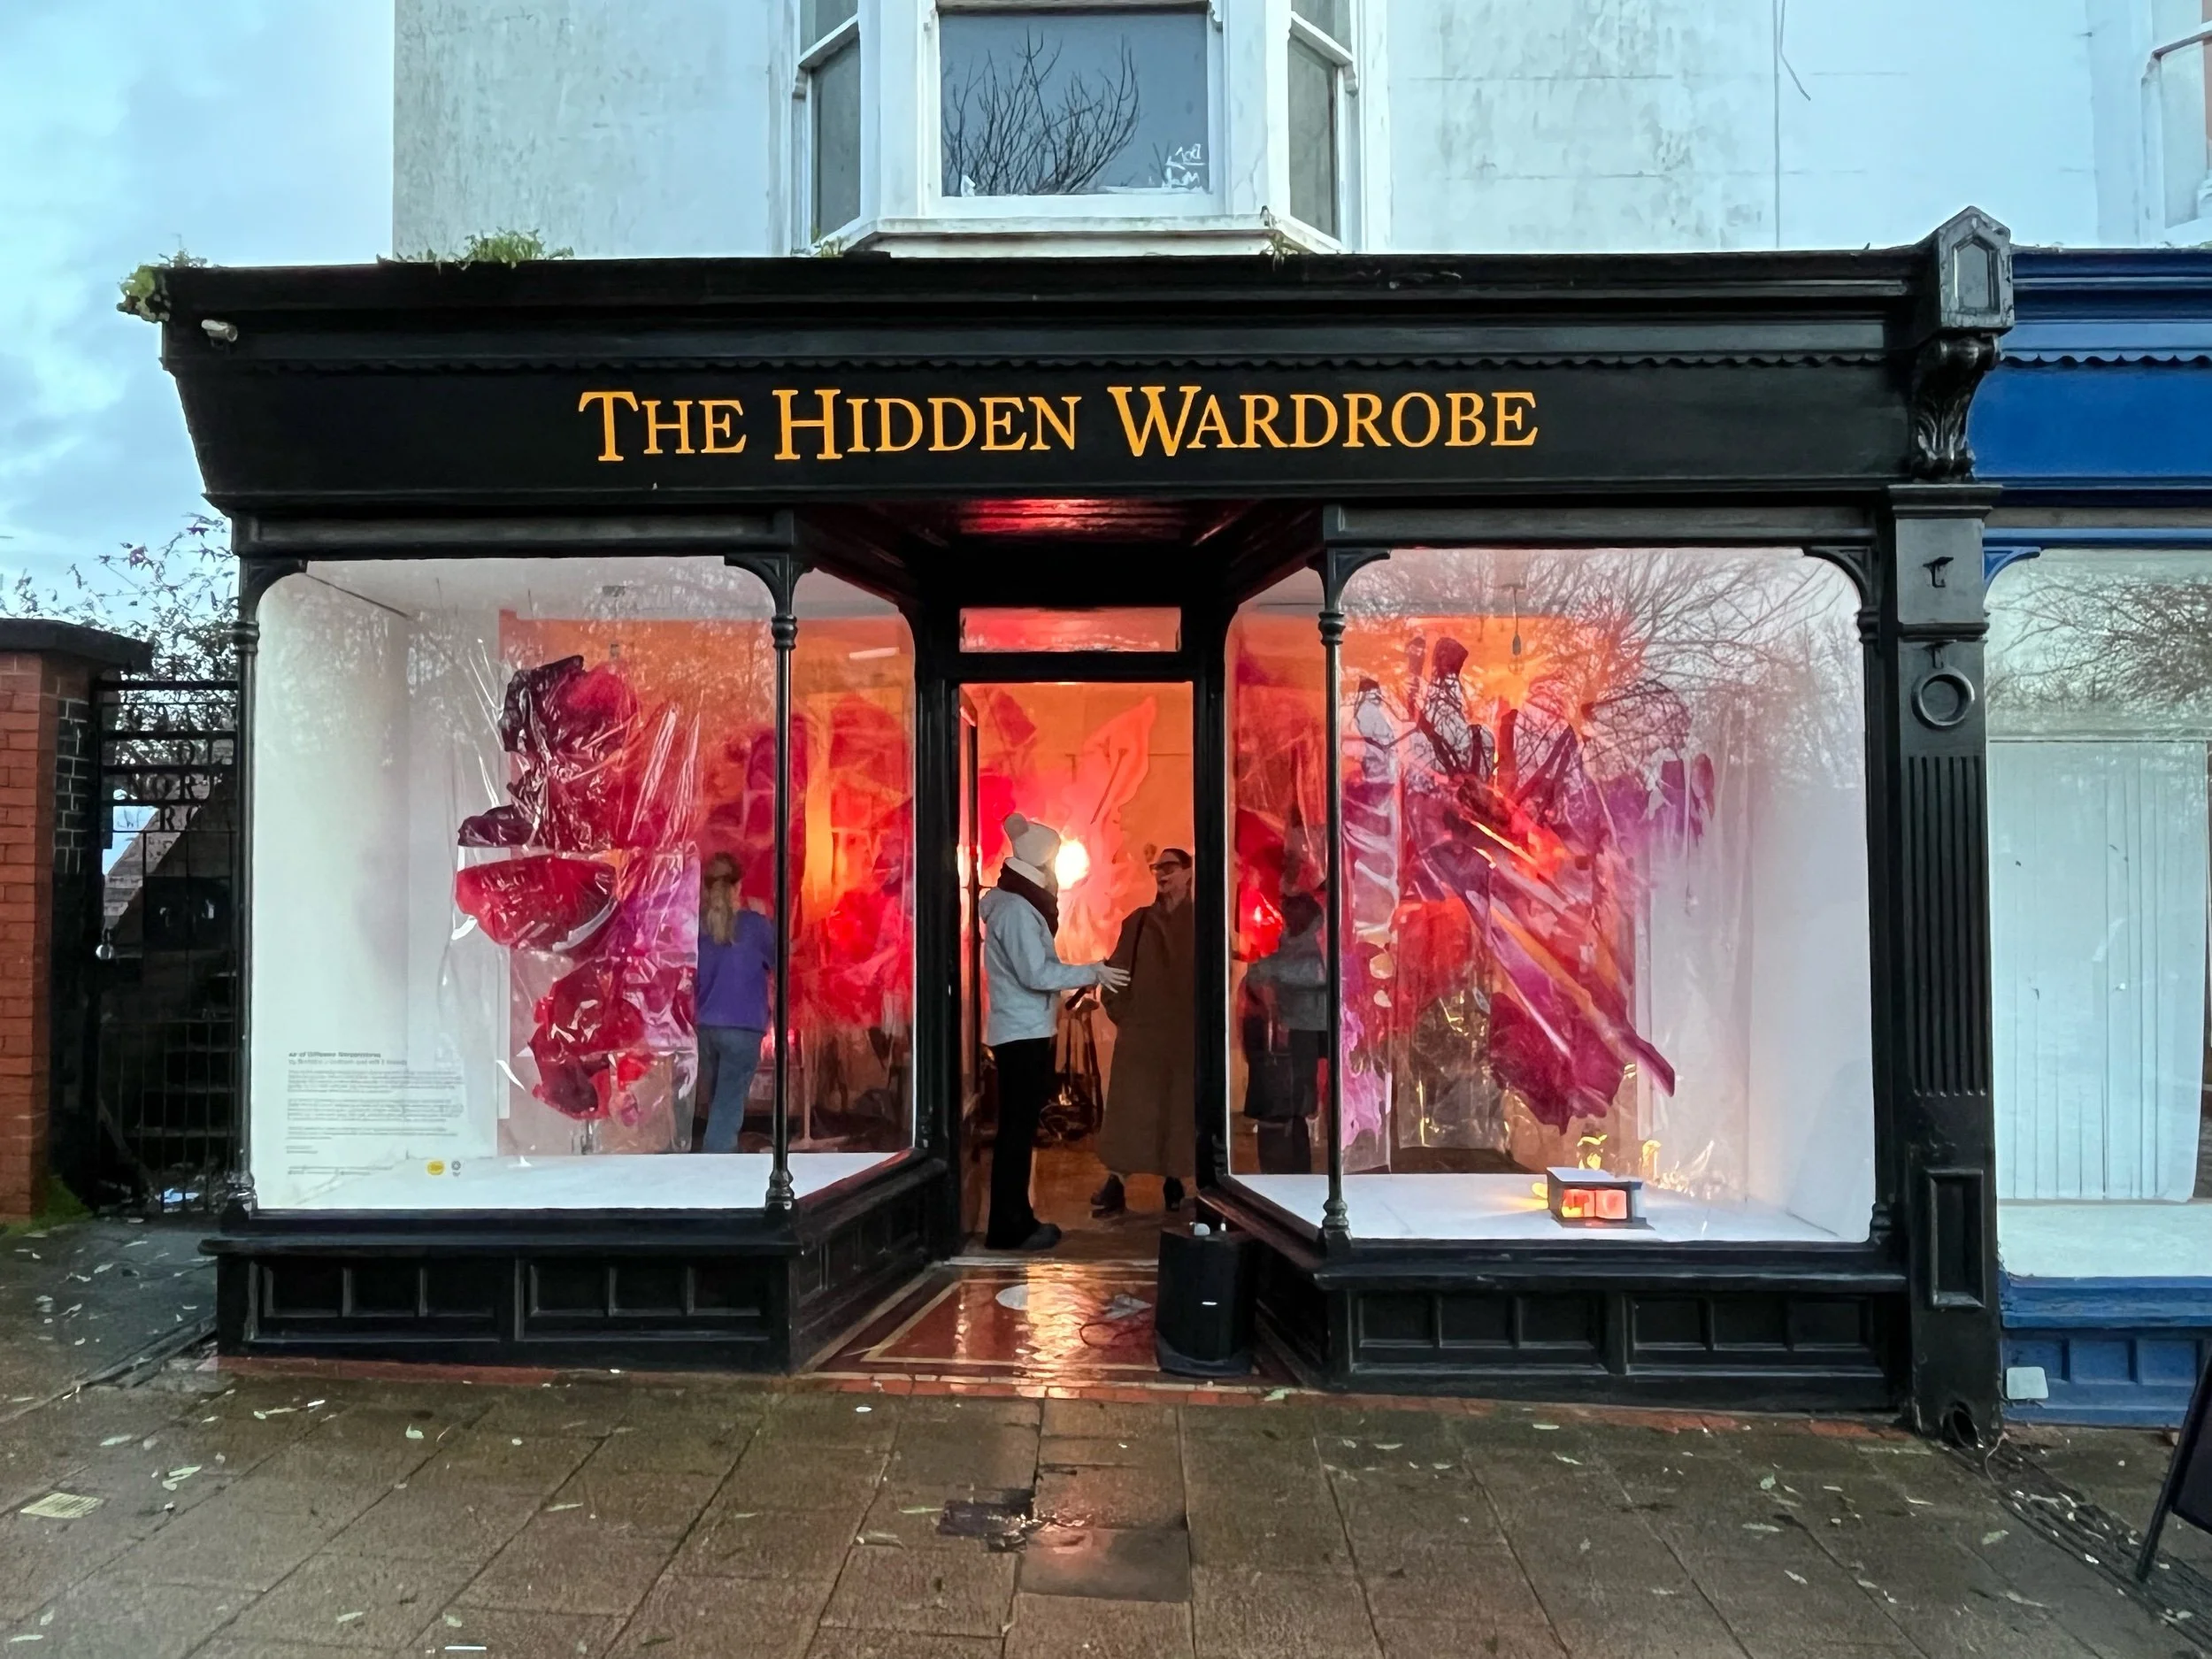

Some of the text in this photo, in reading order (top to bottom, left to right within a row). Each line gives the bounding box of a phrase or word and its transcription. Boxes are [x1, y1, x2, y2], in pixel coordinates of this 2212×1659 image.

[578, 385, 1539, 462] THE HIDDEN WARDROBE
